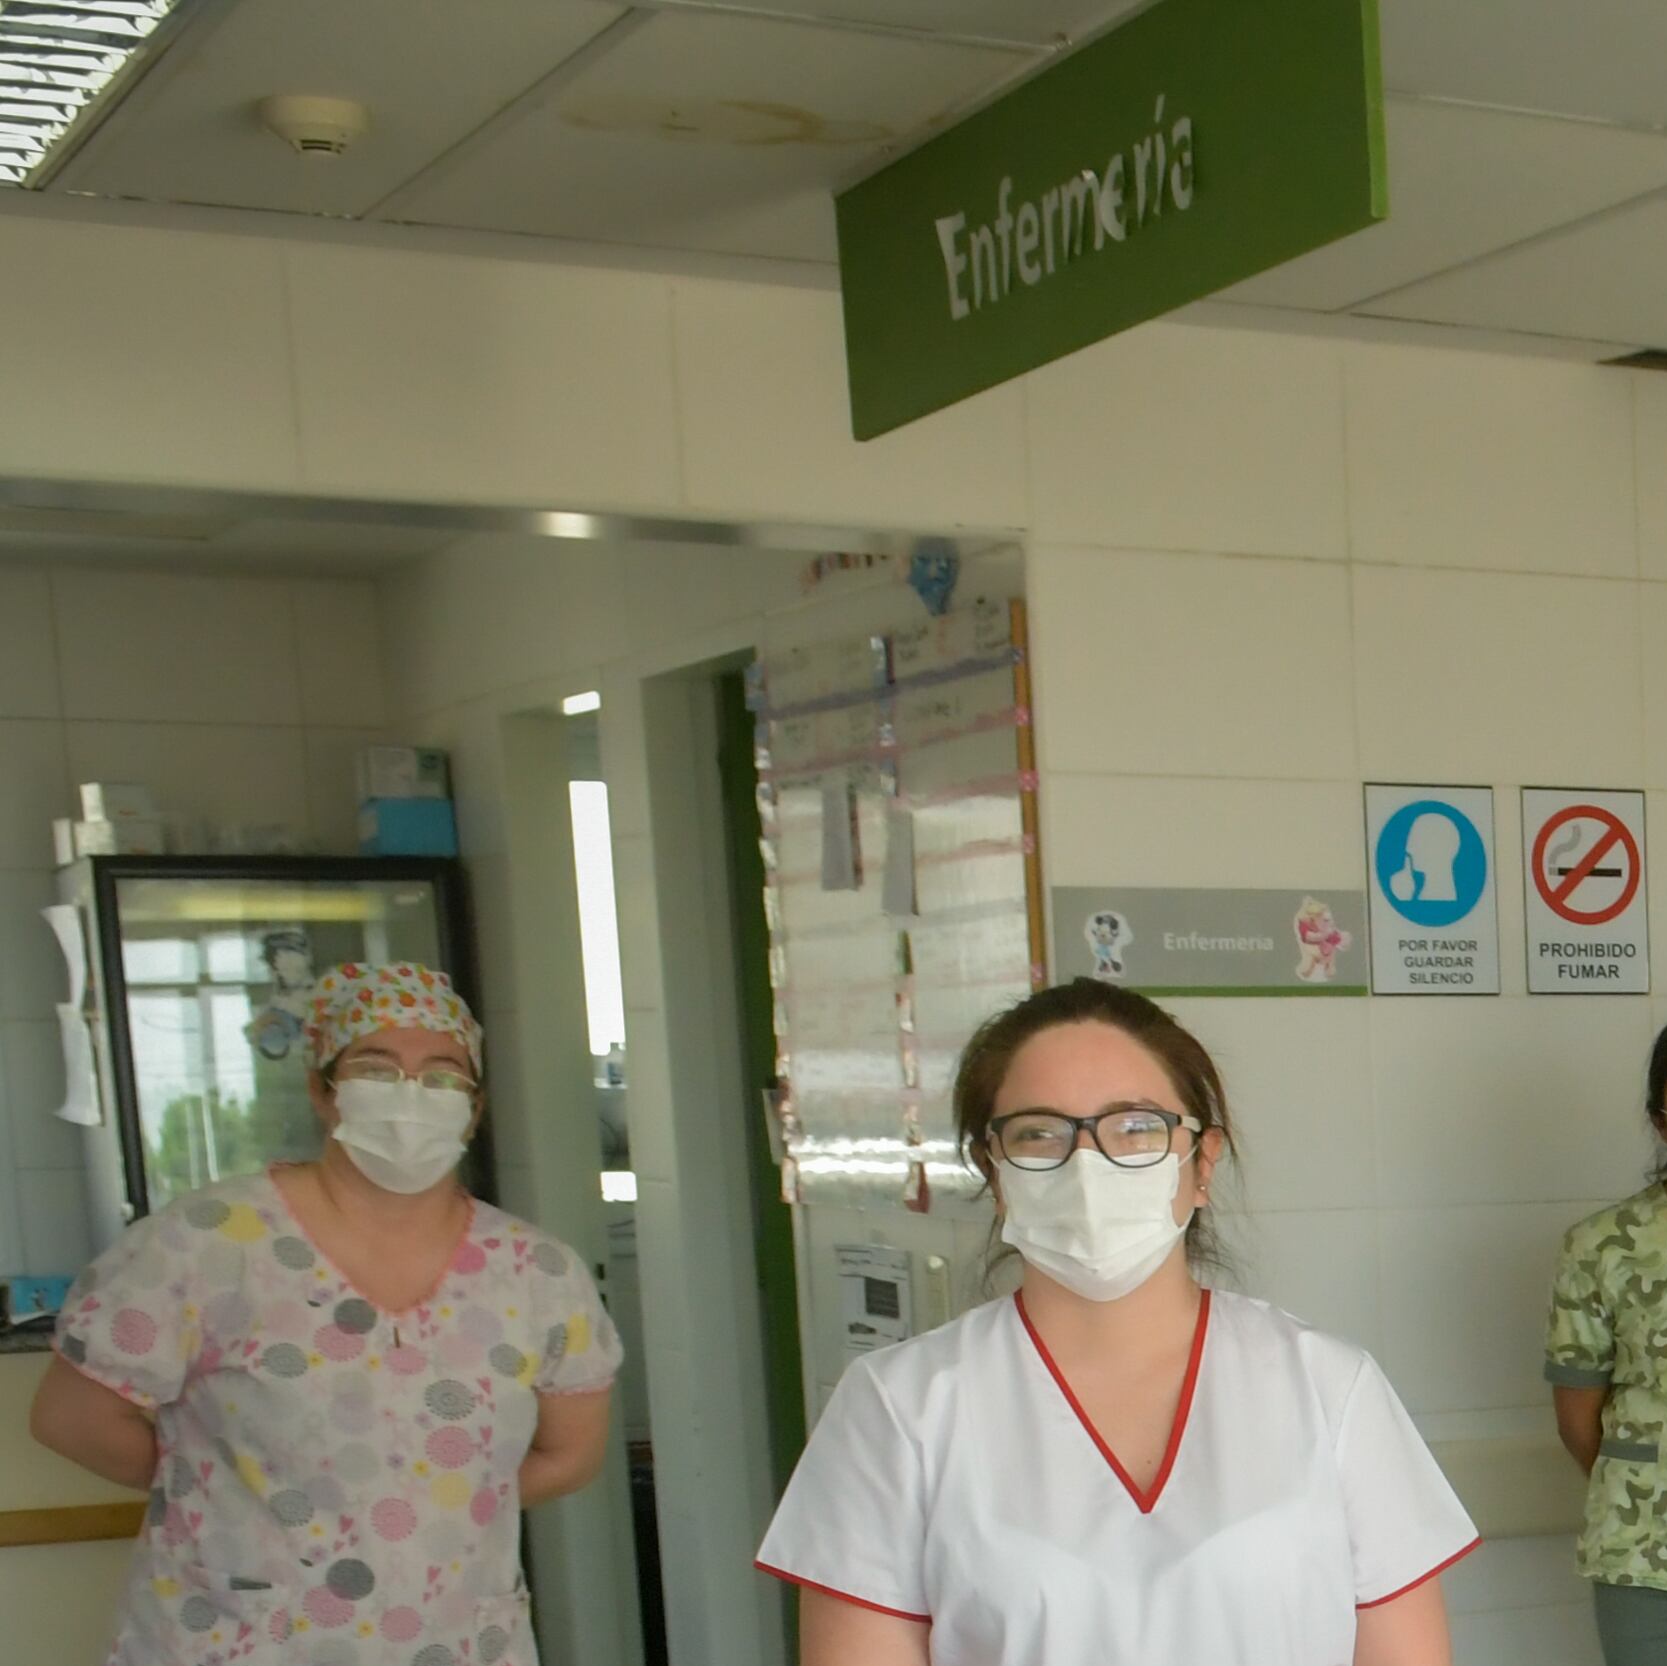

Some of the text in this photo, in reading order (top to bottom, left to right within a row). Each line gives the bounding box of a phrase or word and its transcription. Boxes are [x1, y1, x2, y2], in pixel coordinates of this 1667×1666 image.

[935, 93, 1194, 322] Enfermería
[1398, 939, 1478, 952] POR FAVOR
[1539, 942, 1637, 958] PROHIBIDO
[1403, 955, 1474, 968] GUARDAR
[1557, 963, 1620, 979] FUMAR
[1408, 972, 1474, 985] SILENCIO
